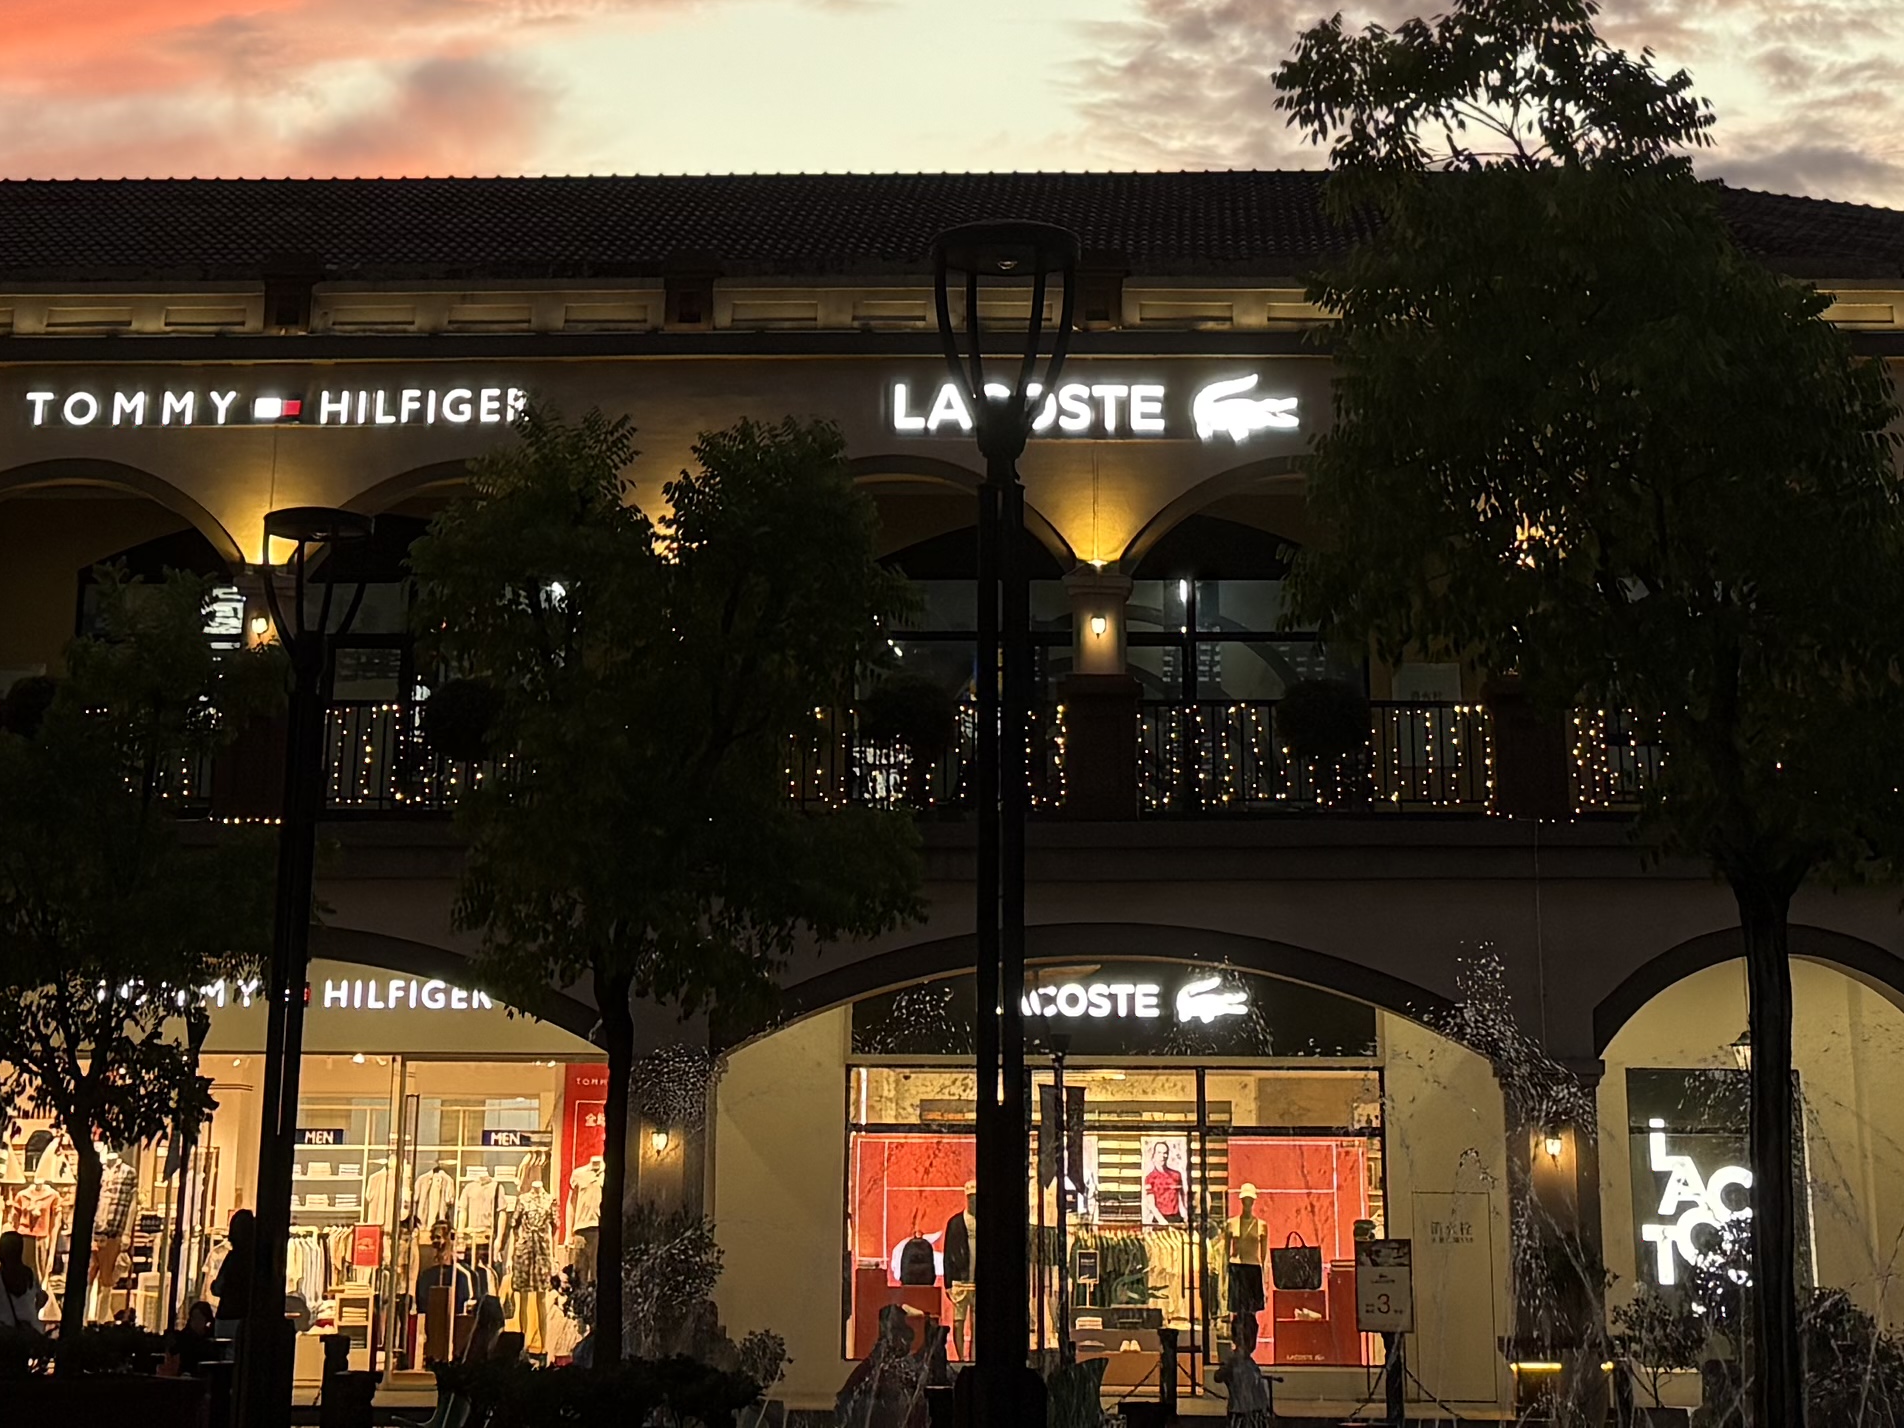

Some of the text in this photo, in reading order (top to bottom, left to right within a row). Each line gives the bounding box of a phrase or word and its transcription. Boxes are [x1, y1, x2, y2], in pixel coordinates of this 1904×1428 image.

[26, 390, 237, 426] TOMMY
[304, 1131, 334, 1144] MEN
[490, 1132, 520, 1145] MEN
